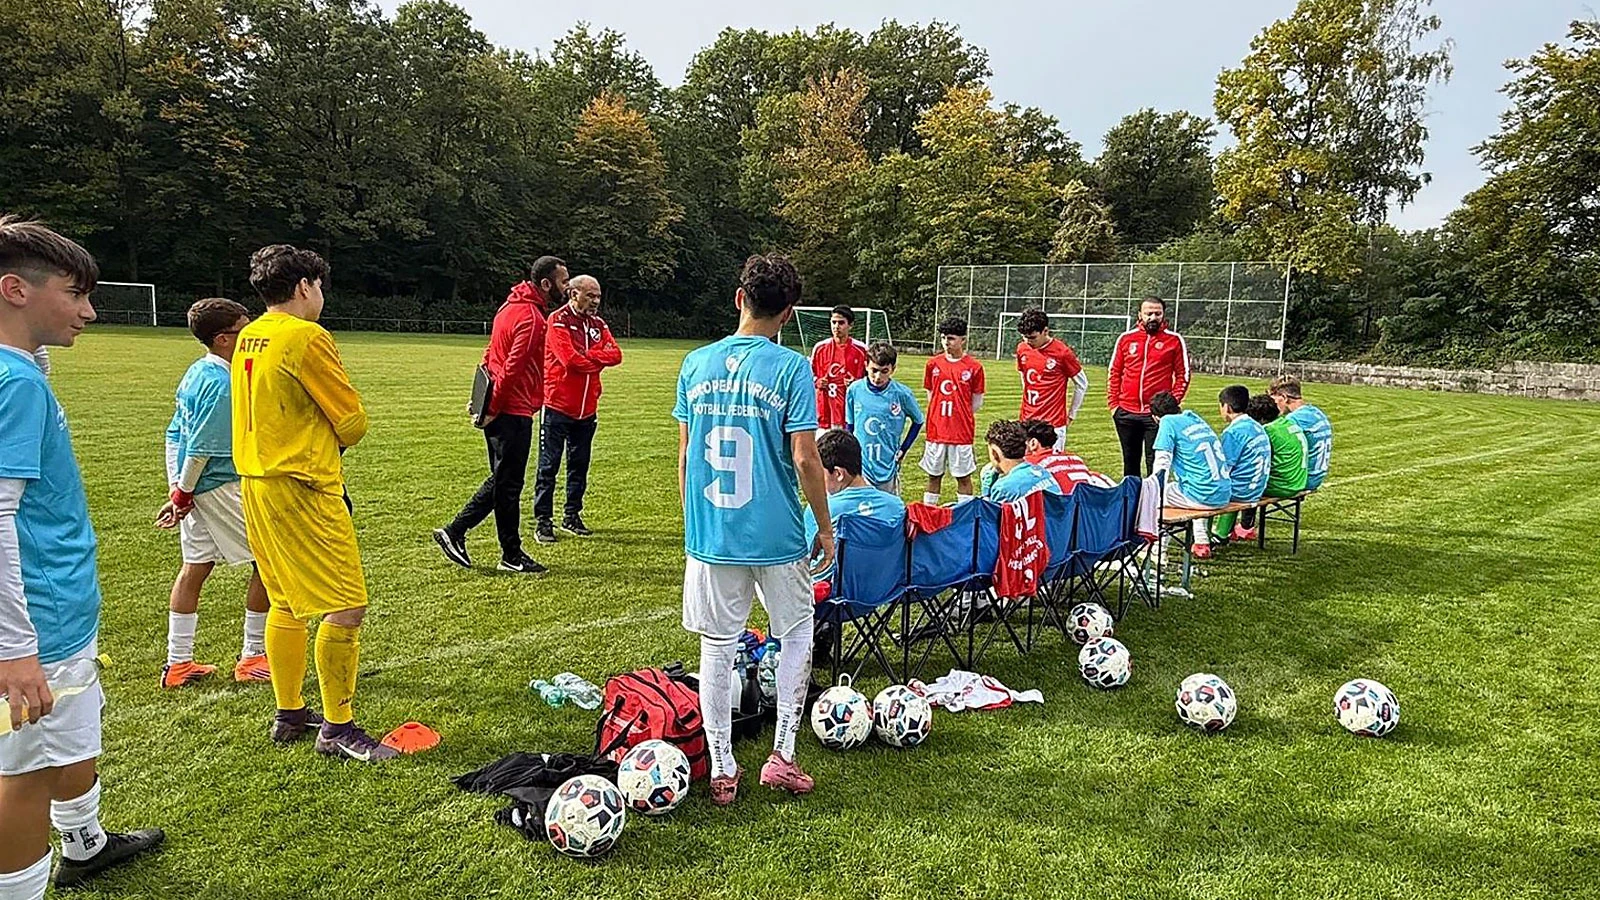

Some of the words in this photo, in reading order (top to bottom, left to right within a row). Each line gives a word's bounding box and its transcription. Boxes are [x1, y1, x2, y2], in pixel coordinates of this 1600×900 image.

[239, 338, 270, 353] ATFF
[244, 358, 254, 432] 1
[827, 382, 838, 398] 8
[939, 400, 954, 417] 11
[865, 442, 881, 462] 11
[703, 425, 754, 509] 9
